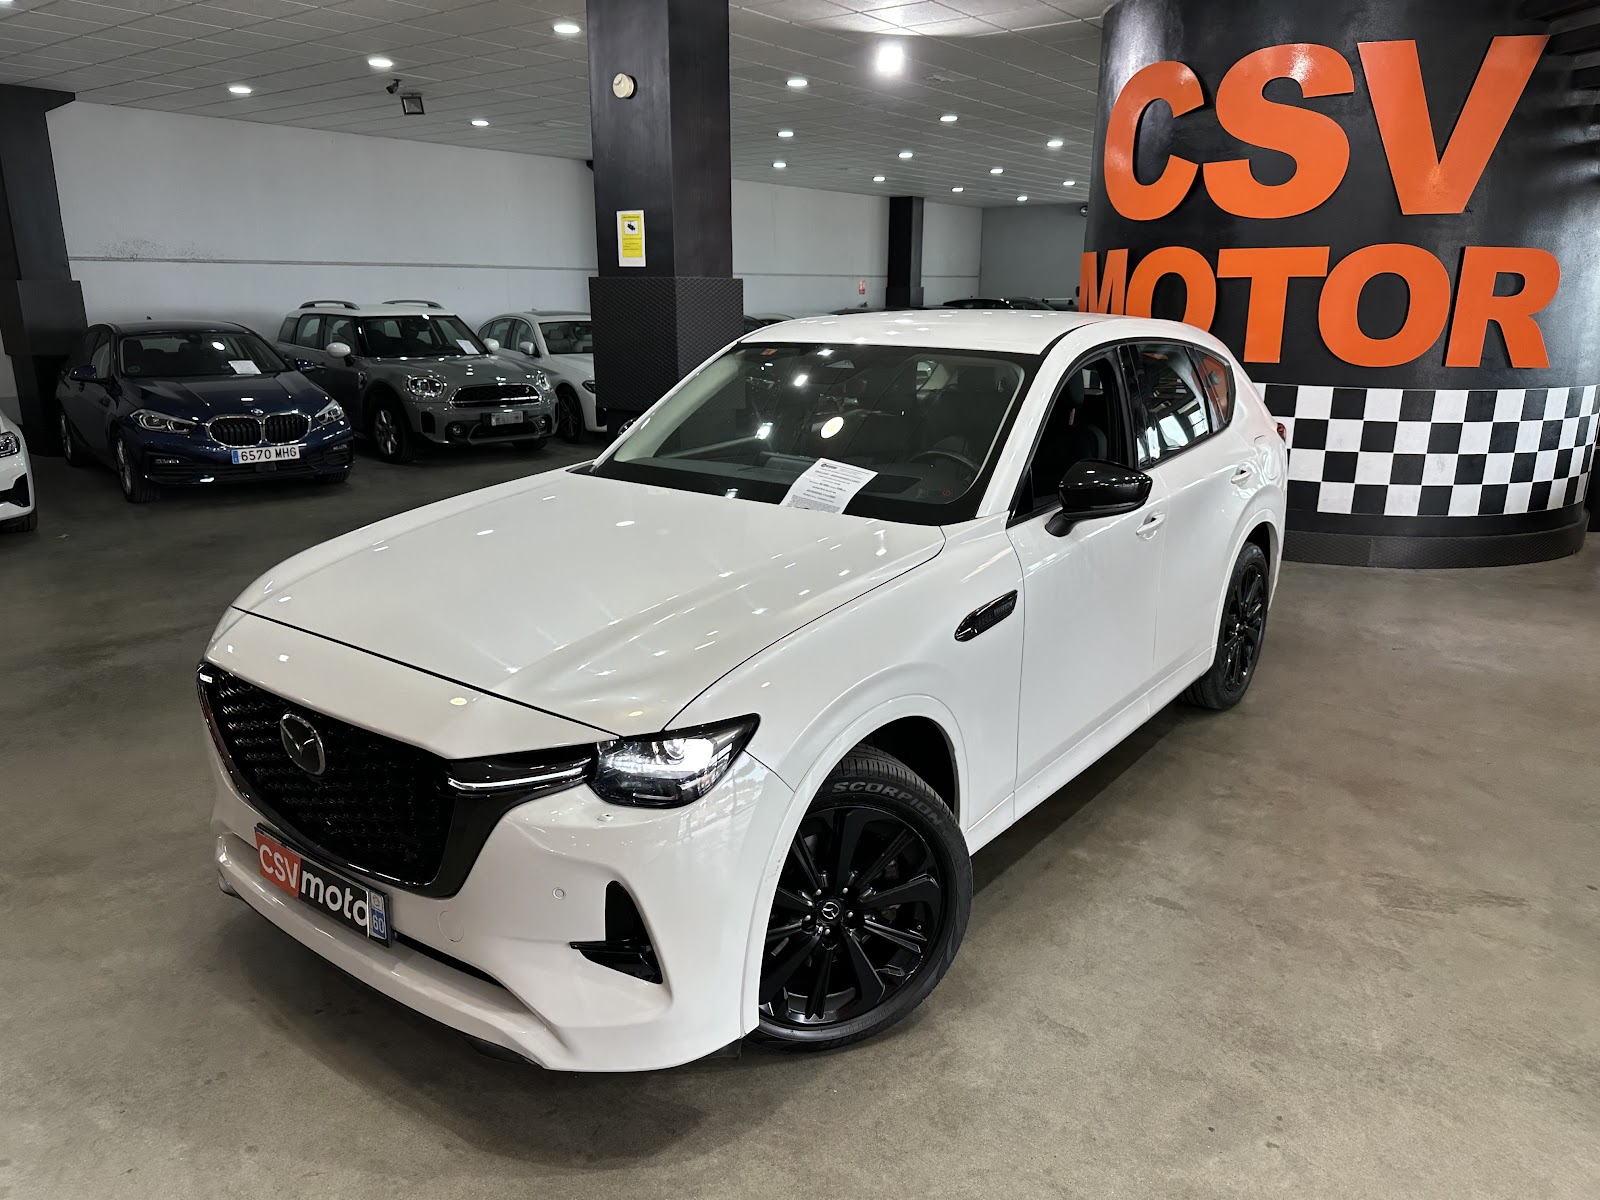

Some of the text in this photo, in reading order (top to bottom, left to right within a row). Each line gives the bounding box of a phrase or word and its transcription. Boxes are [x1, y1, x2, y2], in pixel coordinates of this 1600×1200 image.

[1104, 35, 1547, 221] CSV
[1078, 244, 1561, 368] MOTOR
[241, 447, 297, 461] 6570 MHG
[832, 781, 942, 825] SCORPION
[372, 914, 385, 934] 60
